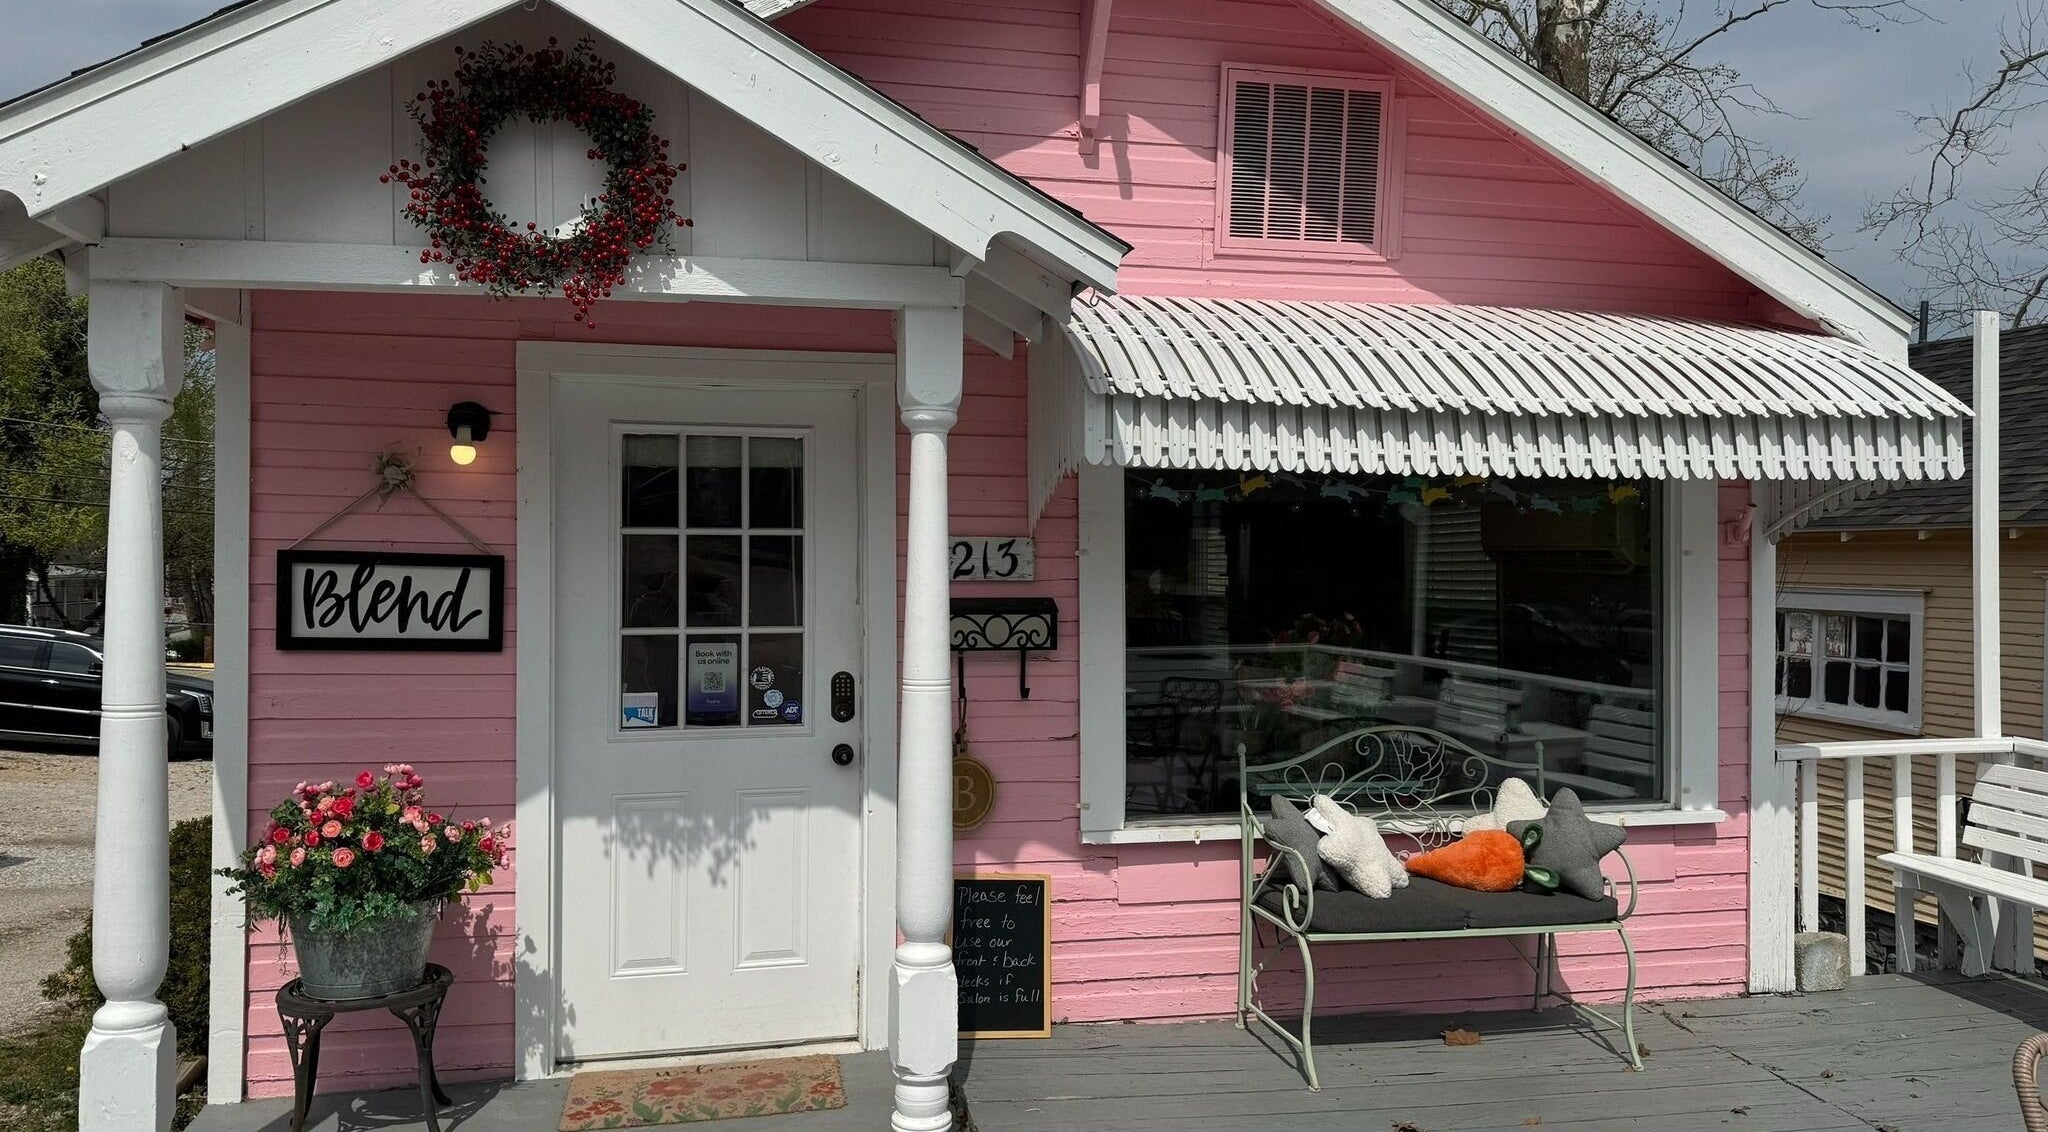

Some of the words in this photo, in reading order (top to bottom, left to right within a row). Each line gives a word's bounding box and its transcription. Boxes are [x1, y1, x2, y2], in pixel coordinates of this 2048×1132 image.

[952, 538, 1018, 579] 213
[303, 561, 482, 633] Blend
[716, 649, 732, 657] with
[637, 708, 654, 718] TALK
[953, 775, 976, 811] B
[958, 886, 1006, 905] Please
[1015, 884, 1040, 906] feel
[960, 906, 991, 930] free
[1001, 913, 1016, 930] to
[955, 936, 981, 948] use
[989, 937, 1013, 948] our
[956, 951, 987, 967] front
[1003, 951, 1037, 968] back
[1000, 973, 1014, 986] if
[1000, 992, 1009, 1003] is
[1015, 988, 1040, 1003] full
